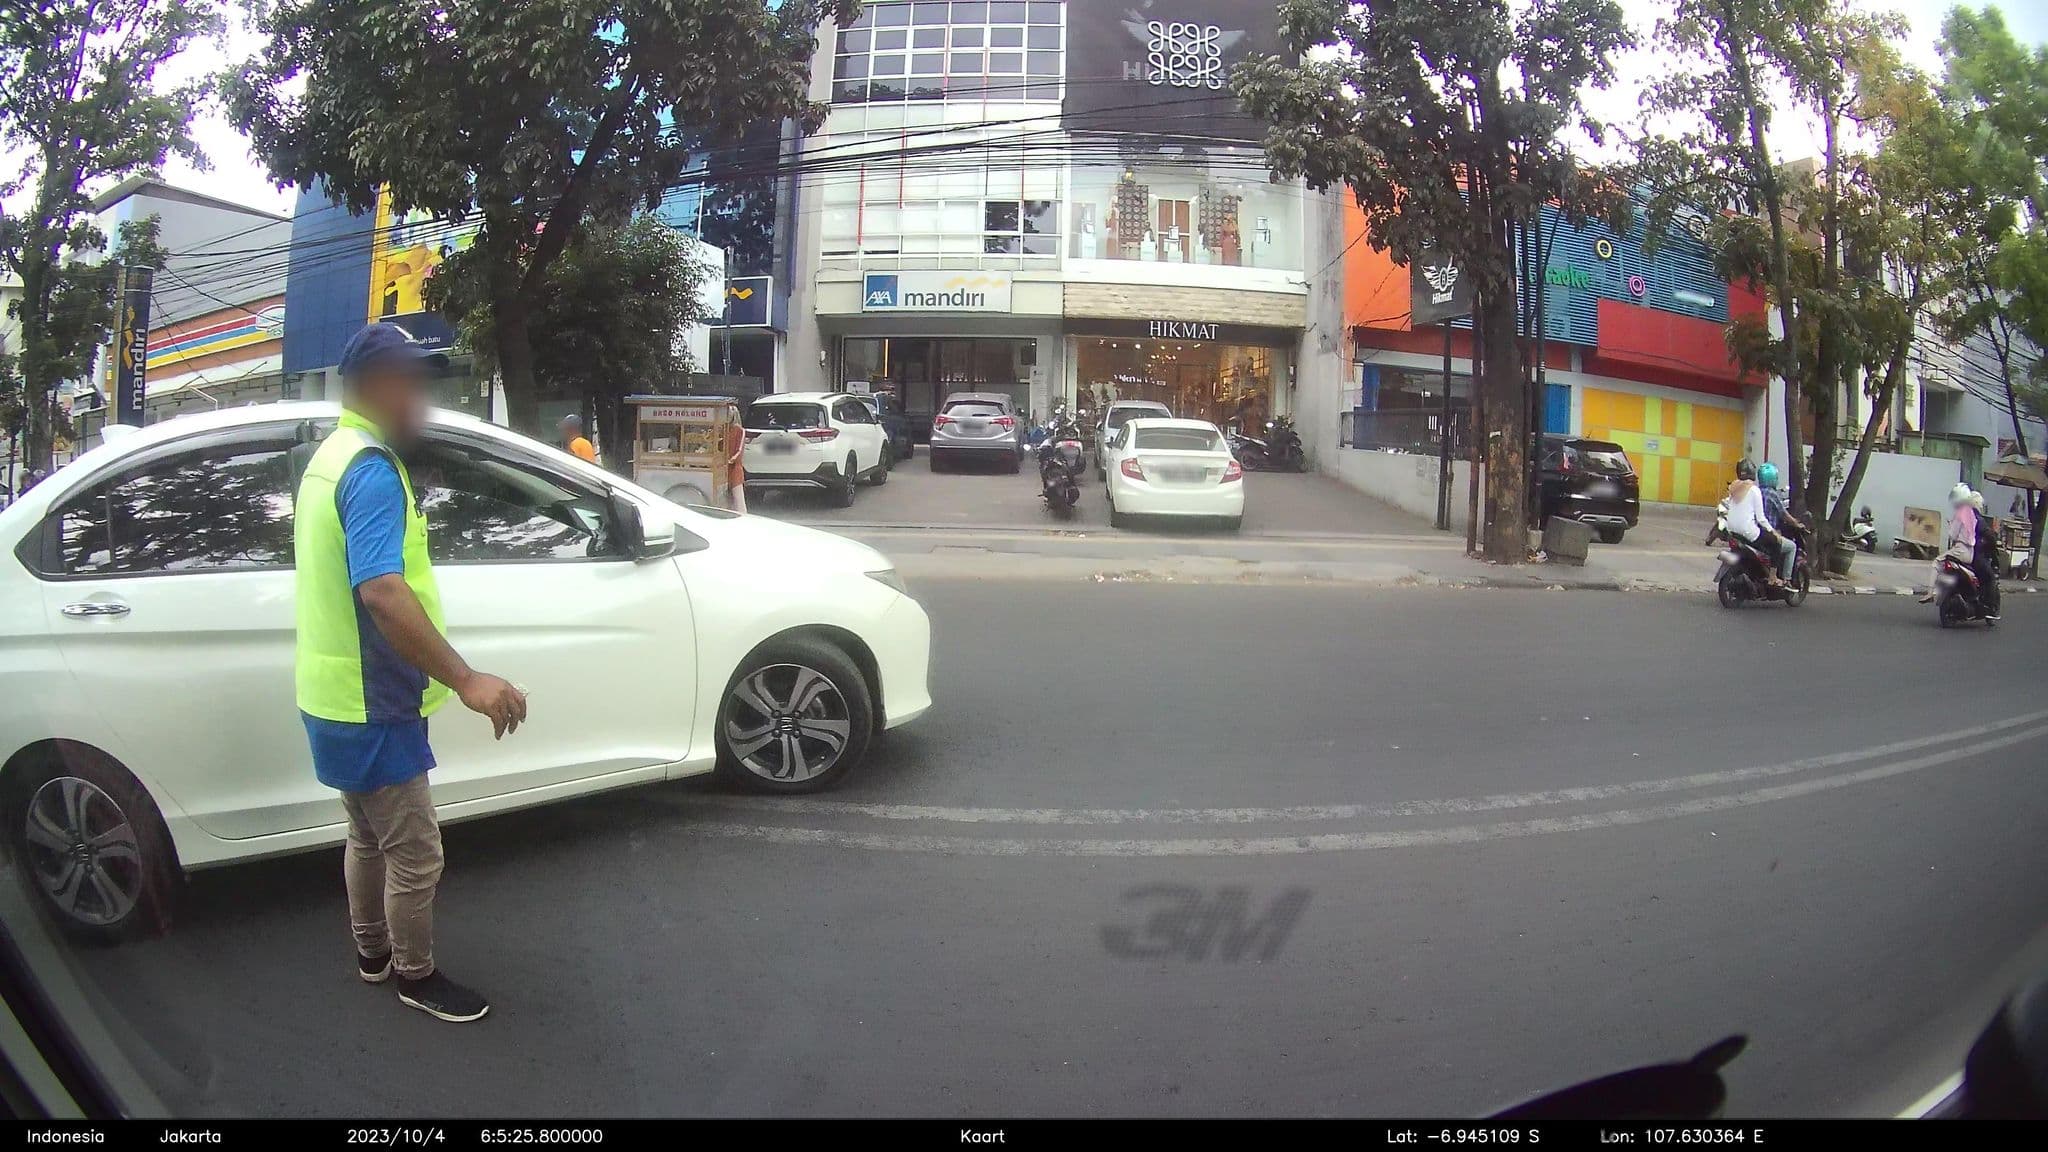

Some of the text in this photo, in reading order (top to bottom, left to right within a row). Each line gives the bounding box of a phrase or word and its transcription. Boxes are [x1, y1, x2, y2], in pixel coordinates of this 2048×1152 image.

[865, 288, 985, 307] AXA mandiri
[1149, 320, 1220, 340] HIKMAT
[131, 328, 146, 411] mandiri
[1100, 884, 1312, 963] 3M
